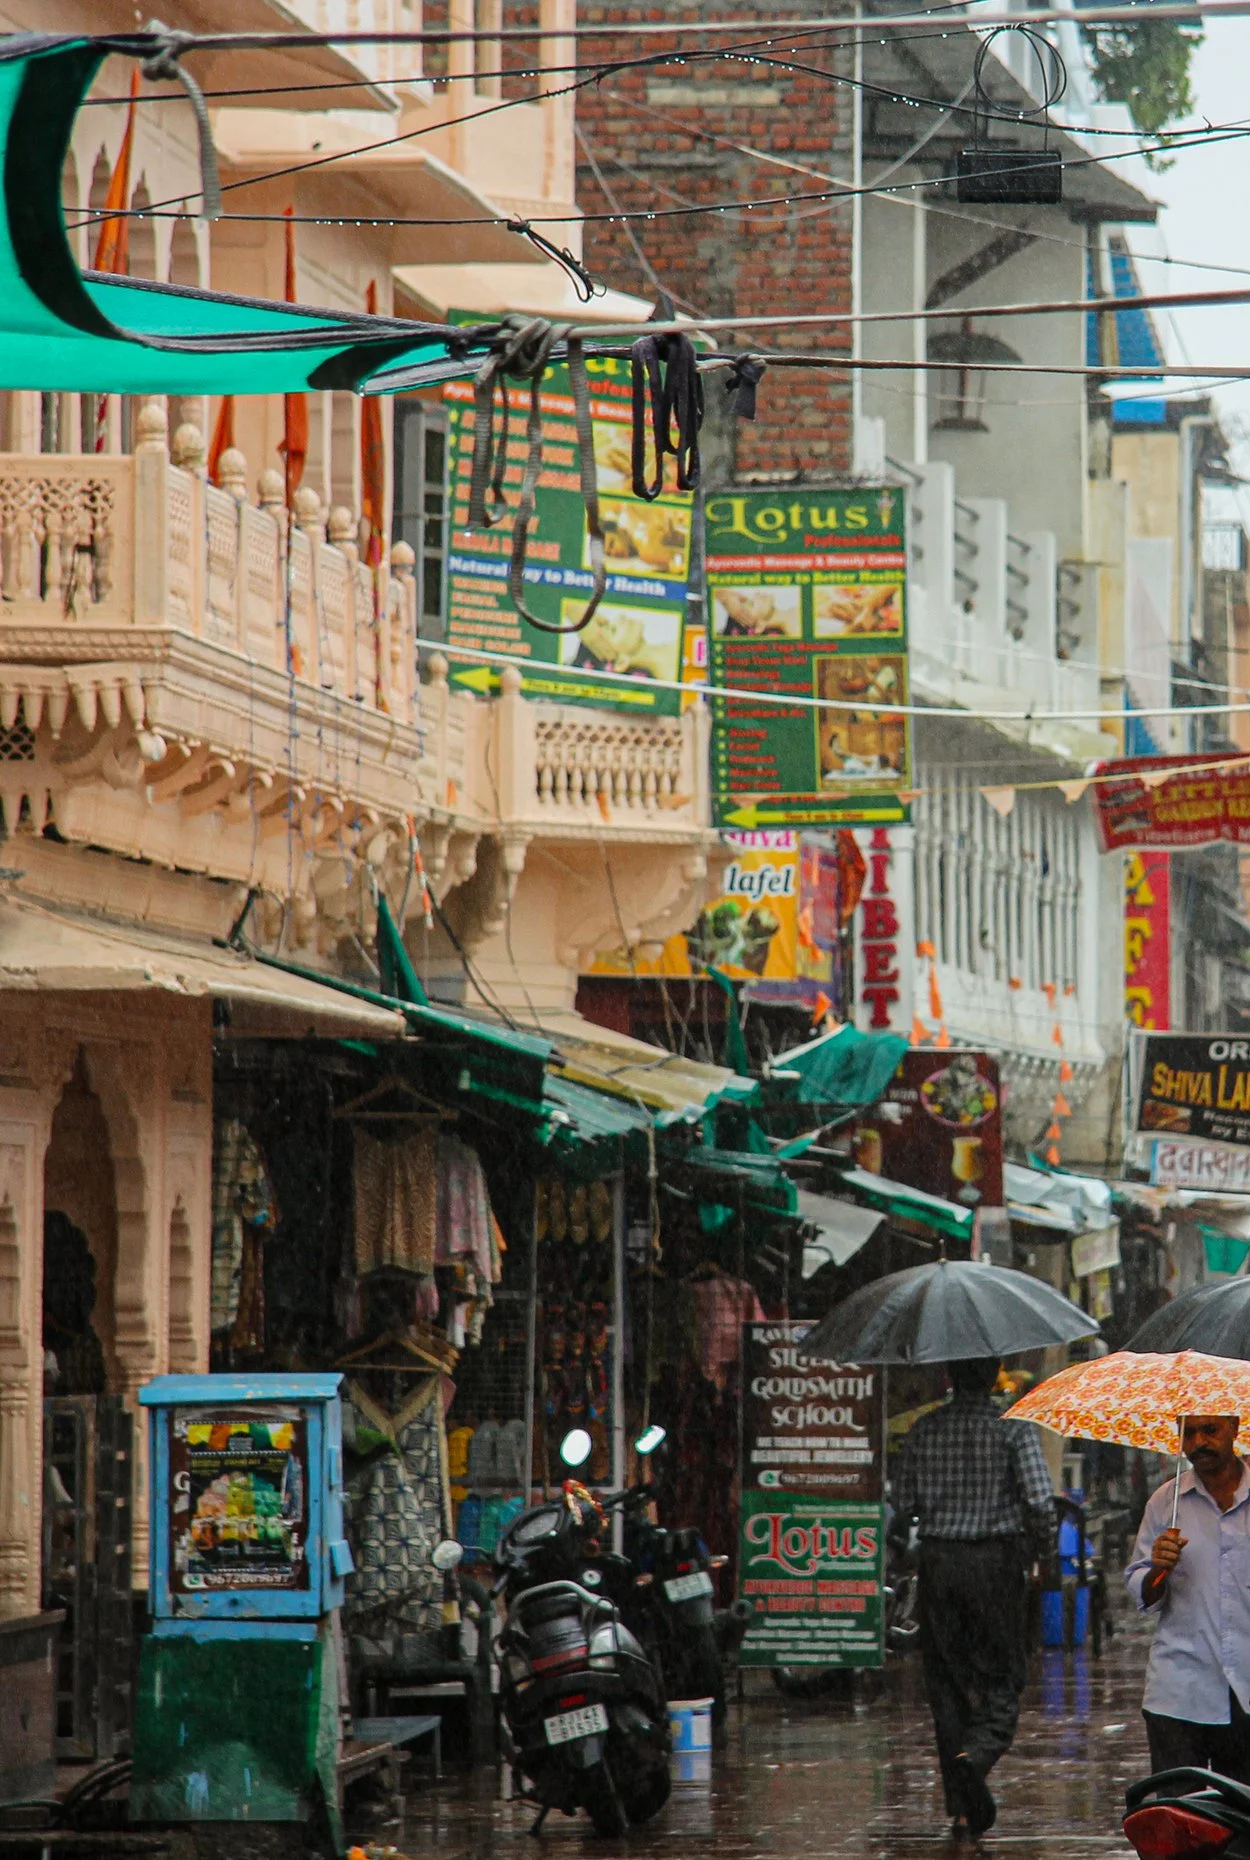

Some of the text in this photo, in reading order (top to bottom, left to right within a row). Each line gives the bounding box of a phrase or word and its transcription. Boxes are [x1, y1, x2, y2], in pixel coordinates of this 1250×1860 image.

[705, 498, 869, 544] Lotus
[546, 570, 562, 583] to
[1151, 1061, 1212, 1107] SHIVA
[751, 1374, 875, 1400] GOLDSMITH
[771, 1402, 867, 1431] SCHOOL
[744, 1512, 879, 1575] Lotus
